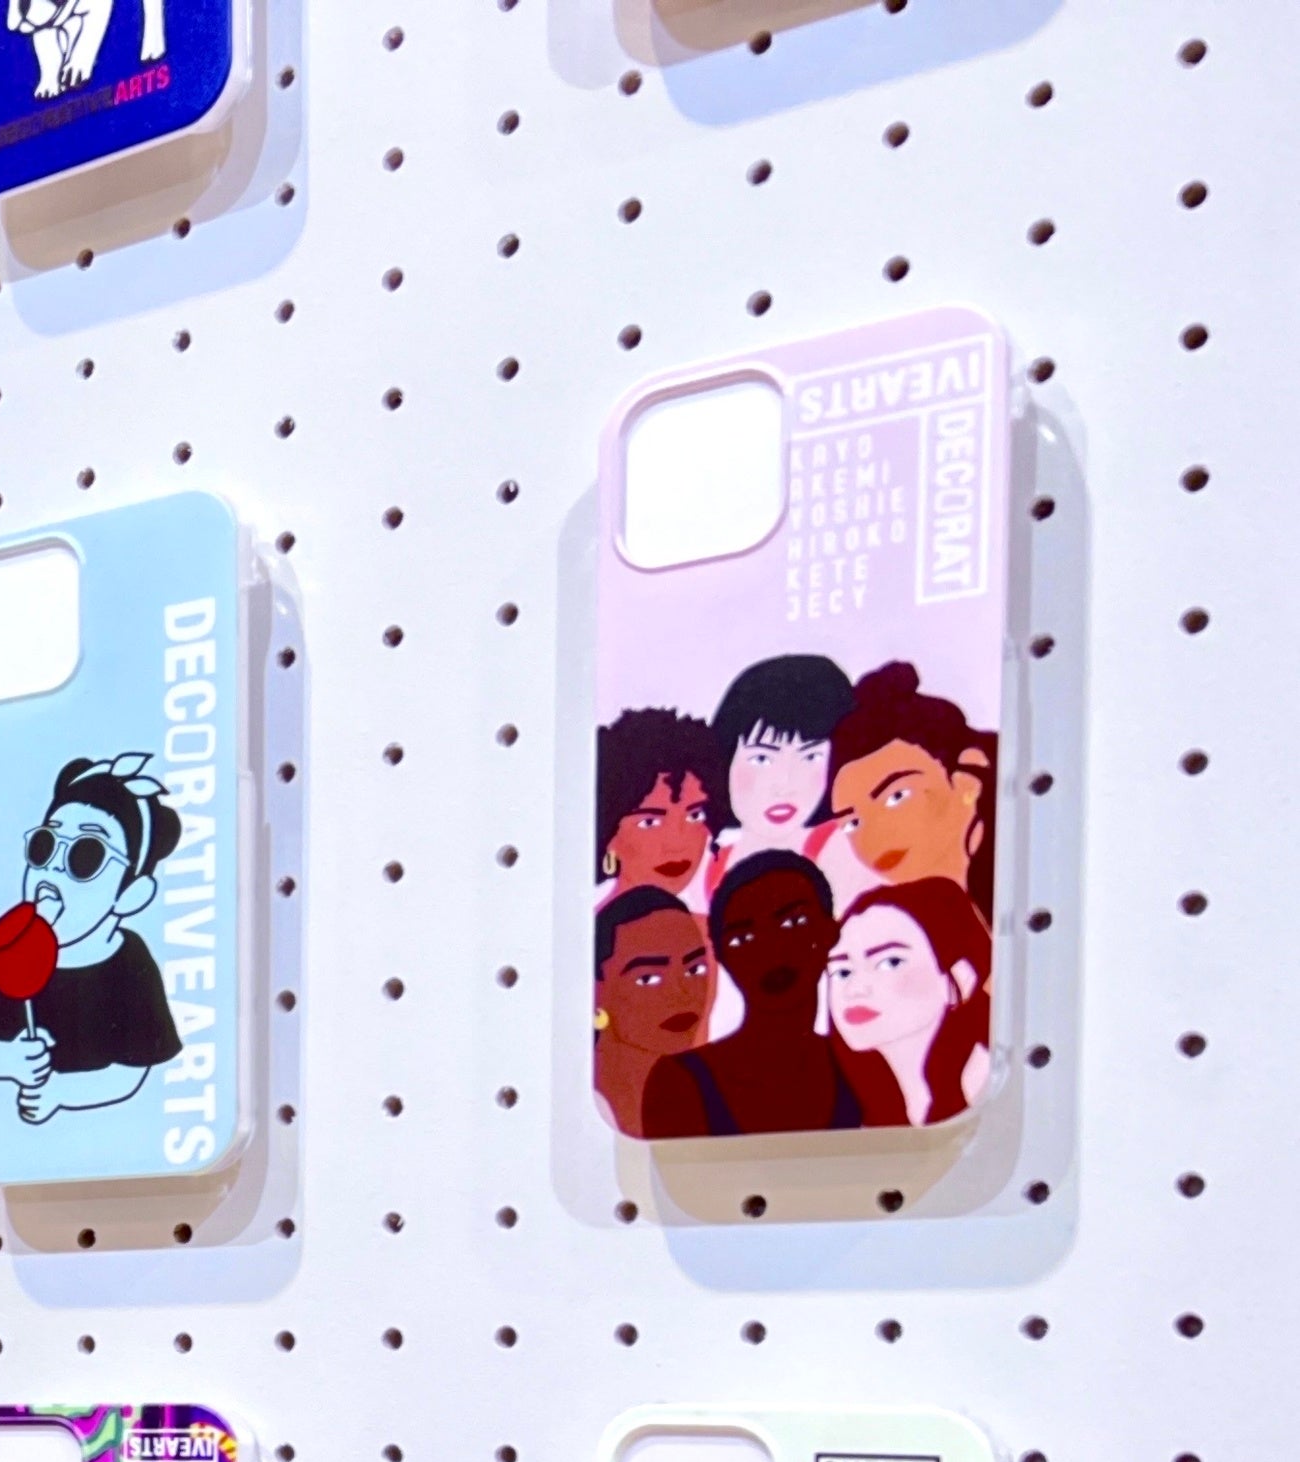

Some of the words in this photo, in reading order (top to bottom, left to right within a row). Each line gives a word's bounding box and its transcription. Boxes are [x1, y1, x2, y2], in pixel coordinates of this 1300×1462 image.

[801, 351, 980, 424] IVEARTS
[932, 408, 976, 586] DECORAT
[787, 517, 907, 562] HIROKO
[163, 596, 216, 1165] DECORATIVEARTS
[130, 1436, 212, 1458] IVEARTS
